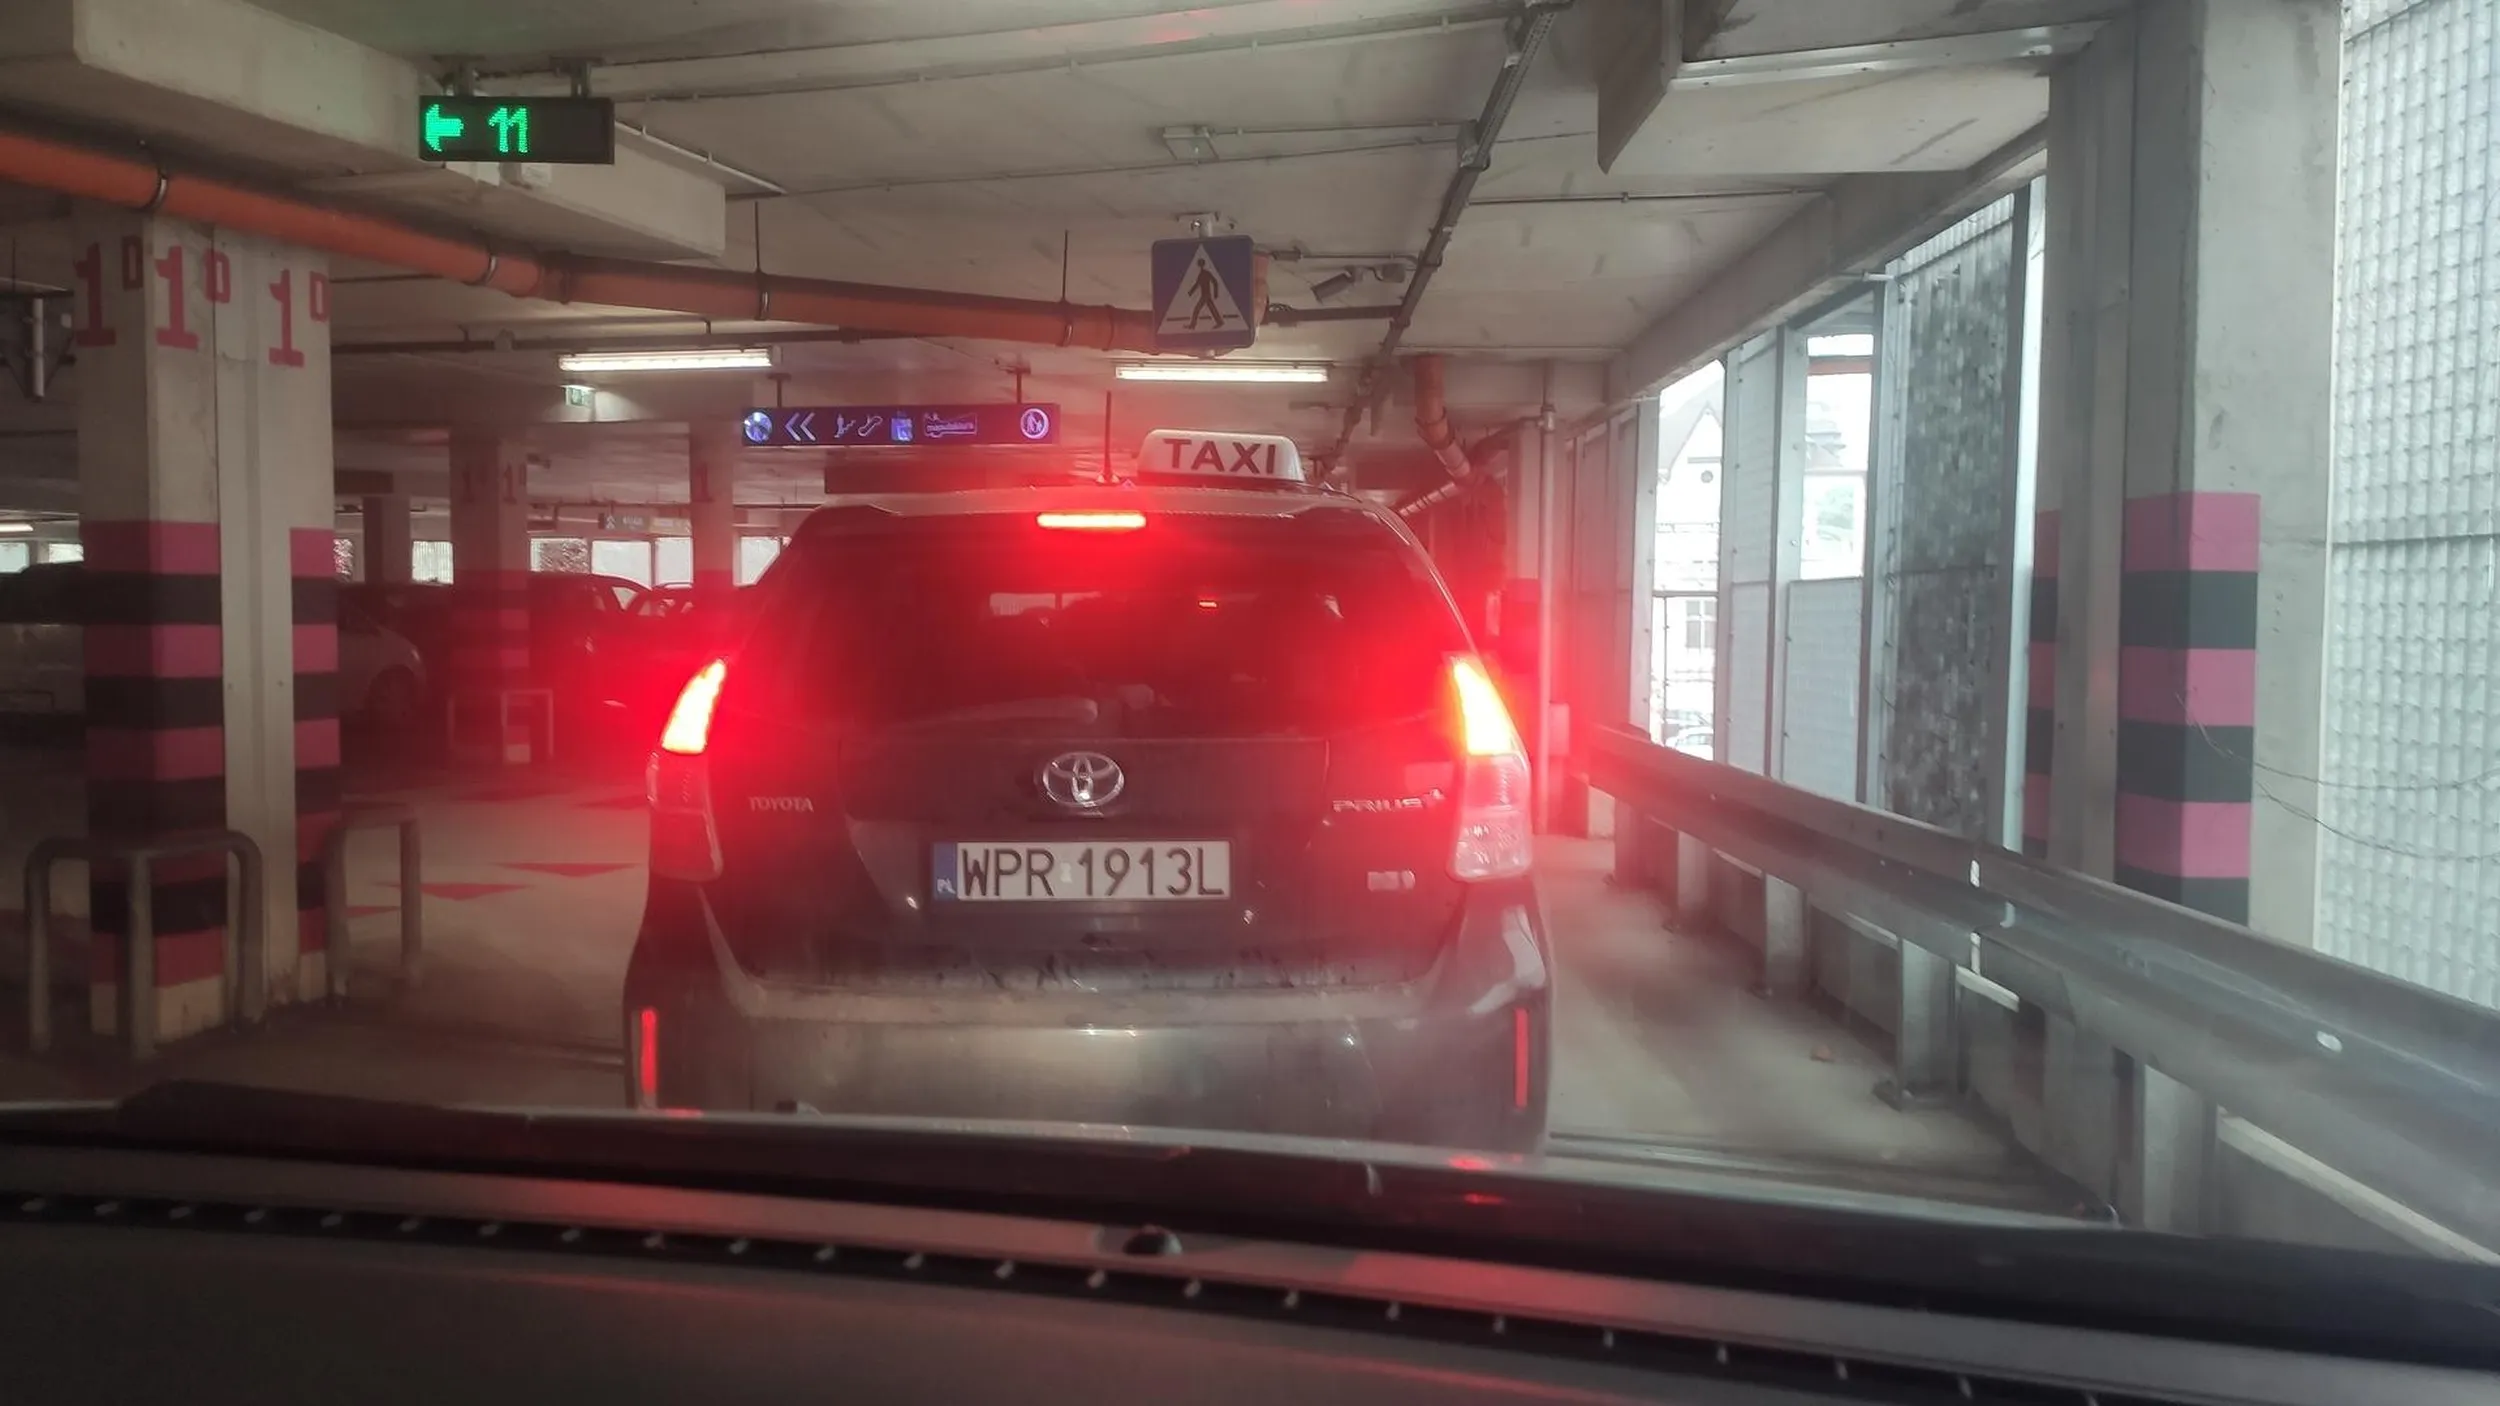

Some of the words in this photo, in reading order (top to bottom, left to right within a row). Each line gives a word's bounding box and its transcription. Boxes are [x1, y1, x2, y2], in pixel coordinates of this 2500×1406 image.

[489, 108, 528, 152] 11
[1163, 438, 1277, 475] TAXI
[748, 796, 815, 813] TOYOTA
[962, 848, 1054, 896] WPR
[1078, 847, 1224, 896] 1913L
